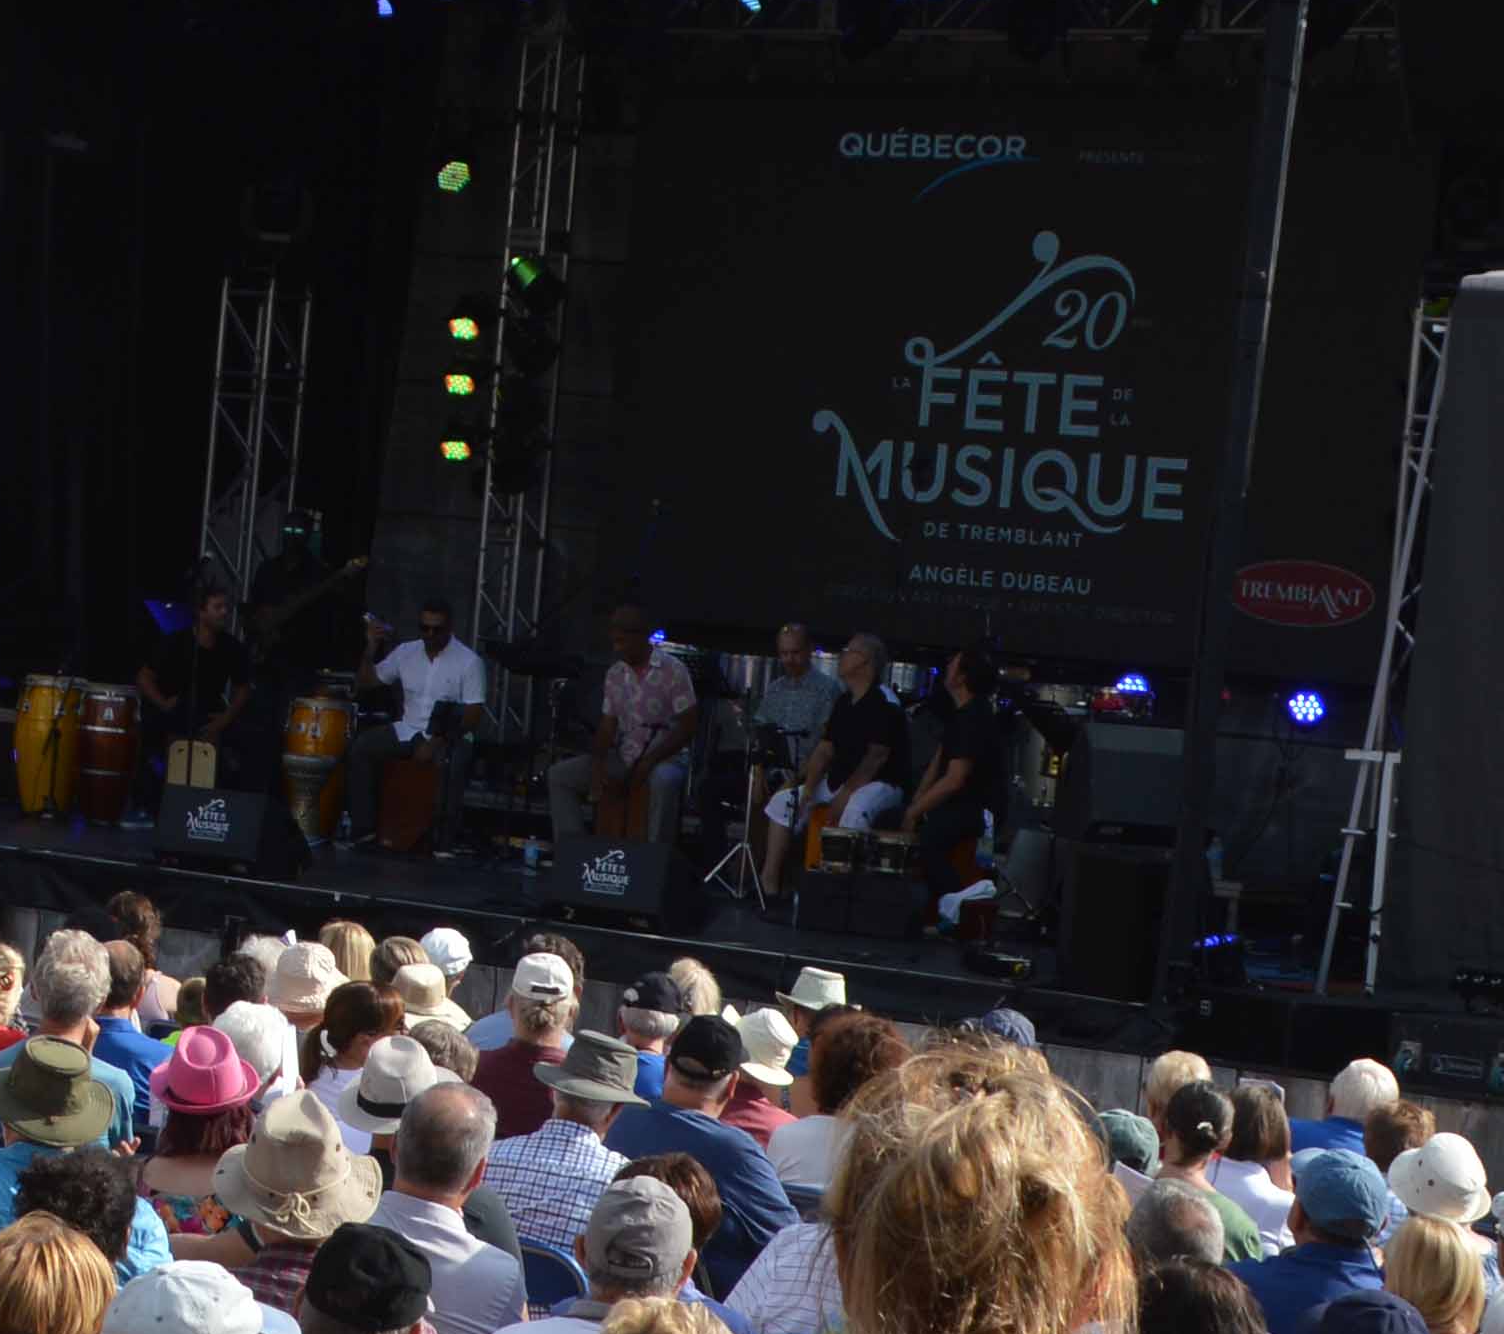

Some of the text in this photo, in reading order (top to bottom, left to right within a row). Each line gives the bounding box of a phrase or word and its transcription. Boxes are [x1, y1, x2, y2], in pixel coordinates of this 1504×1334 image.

[839, 127, 1028, 161] QUÉBECOR
[1042, 289, 1129, 352] 20
[912, 343, 1106, 438] FÊTE
[1112, 387, 1134, 402] DE
[1109, 411, 1132, 428] LA
[812, 409, 1189, 539] MUSIQUE
[923, 521, 1084, 549] DE TREMBLANT
[909, 561, 1093, 597] ANGÈLE DUBEAU
[1238, 577, 1364, 621] TREMBLANT
